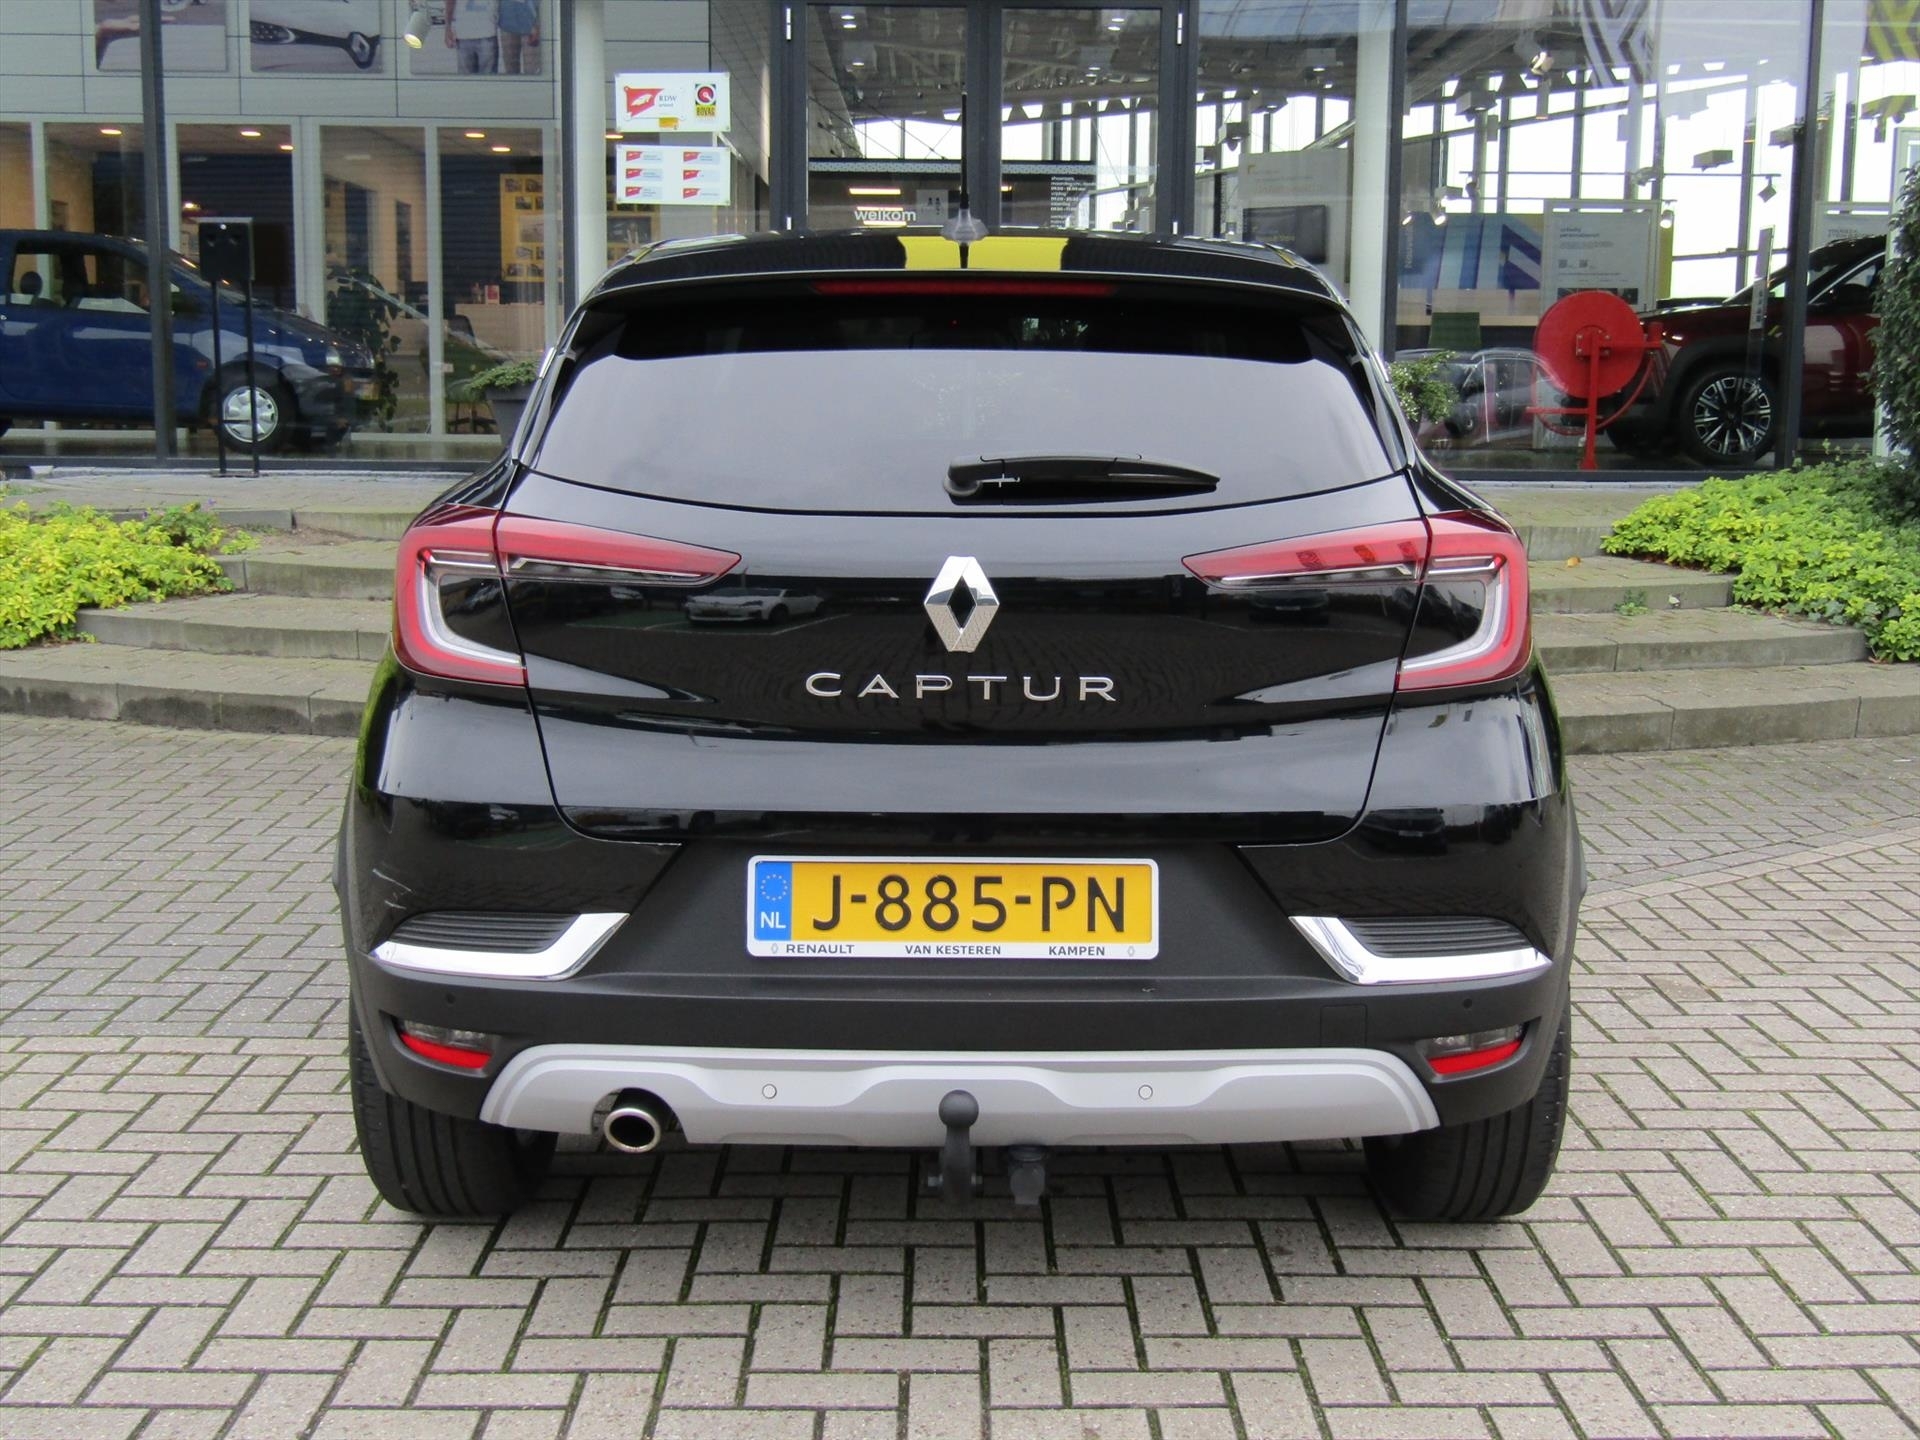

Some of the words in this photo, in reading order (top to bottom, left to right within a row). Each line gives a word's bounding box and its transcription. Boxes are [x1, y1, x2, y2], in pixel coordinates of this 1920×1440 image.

[854, 208, 917, 221] welkom
[805, 672, 1117, 702] CAPTUR
[812, 873, 1125, 933] J-885-PN
[760, 911, 786, 929] NL
[785, 943, 855, 955] RENAULT
[905, 944, 933, 956] VAN
[935, 944, 1002, 956] KESTEREN
[1048, 945, 1105, 957] KAMPEN
